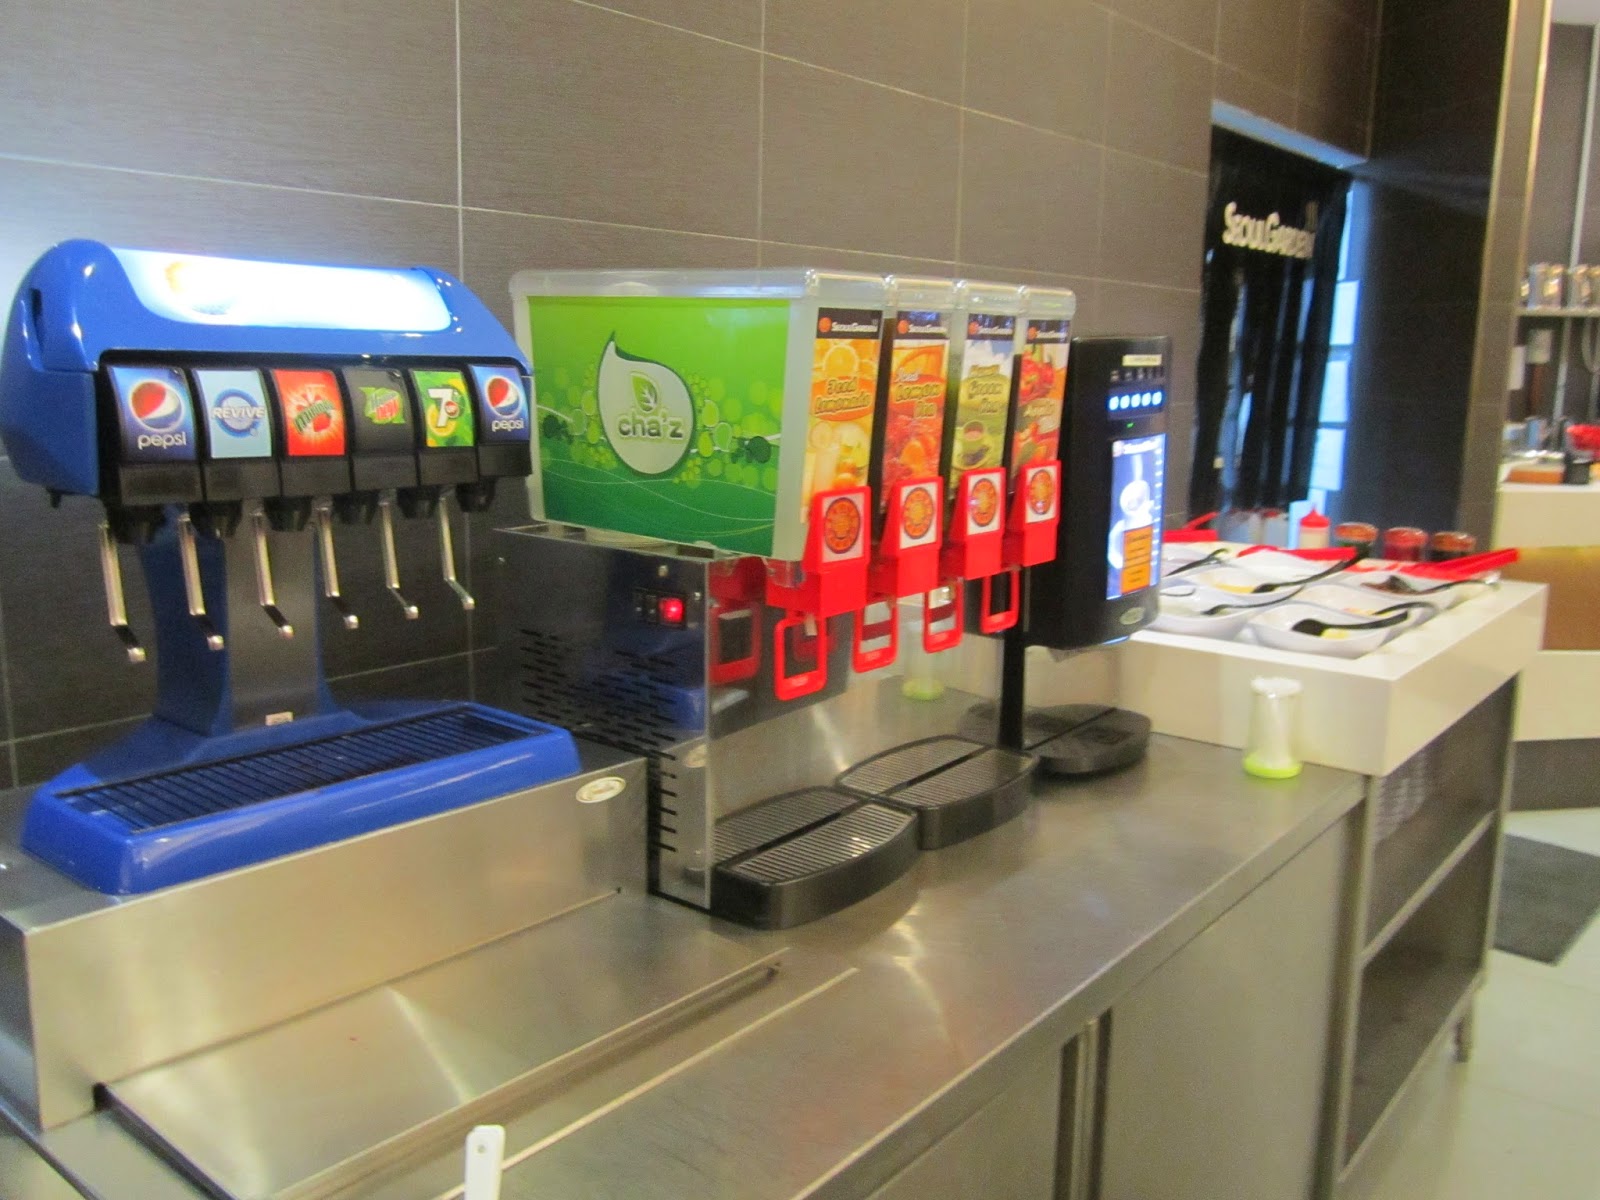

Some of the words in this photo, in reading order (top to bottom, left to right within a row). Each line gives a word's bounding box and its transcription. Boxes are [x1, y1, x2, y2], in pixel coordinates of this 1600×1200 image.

[212, 405, 266, 420] REVIVE
[491, 418, 525, 433] pepsi
[618, 411, 684, 438] cha'z
[137, 431, 188, 450] pepsi
